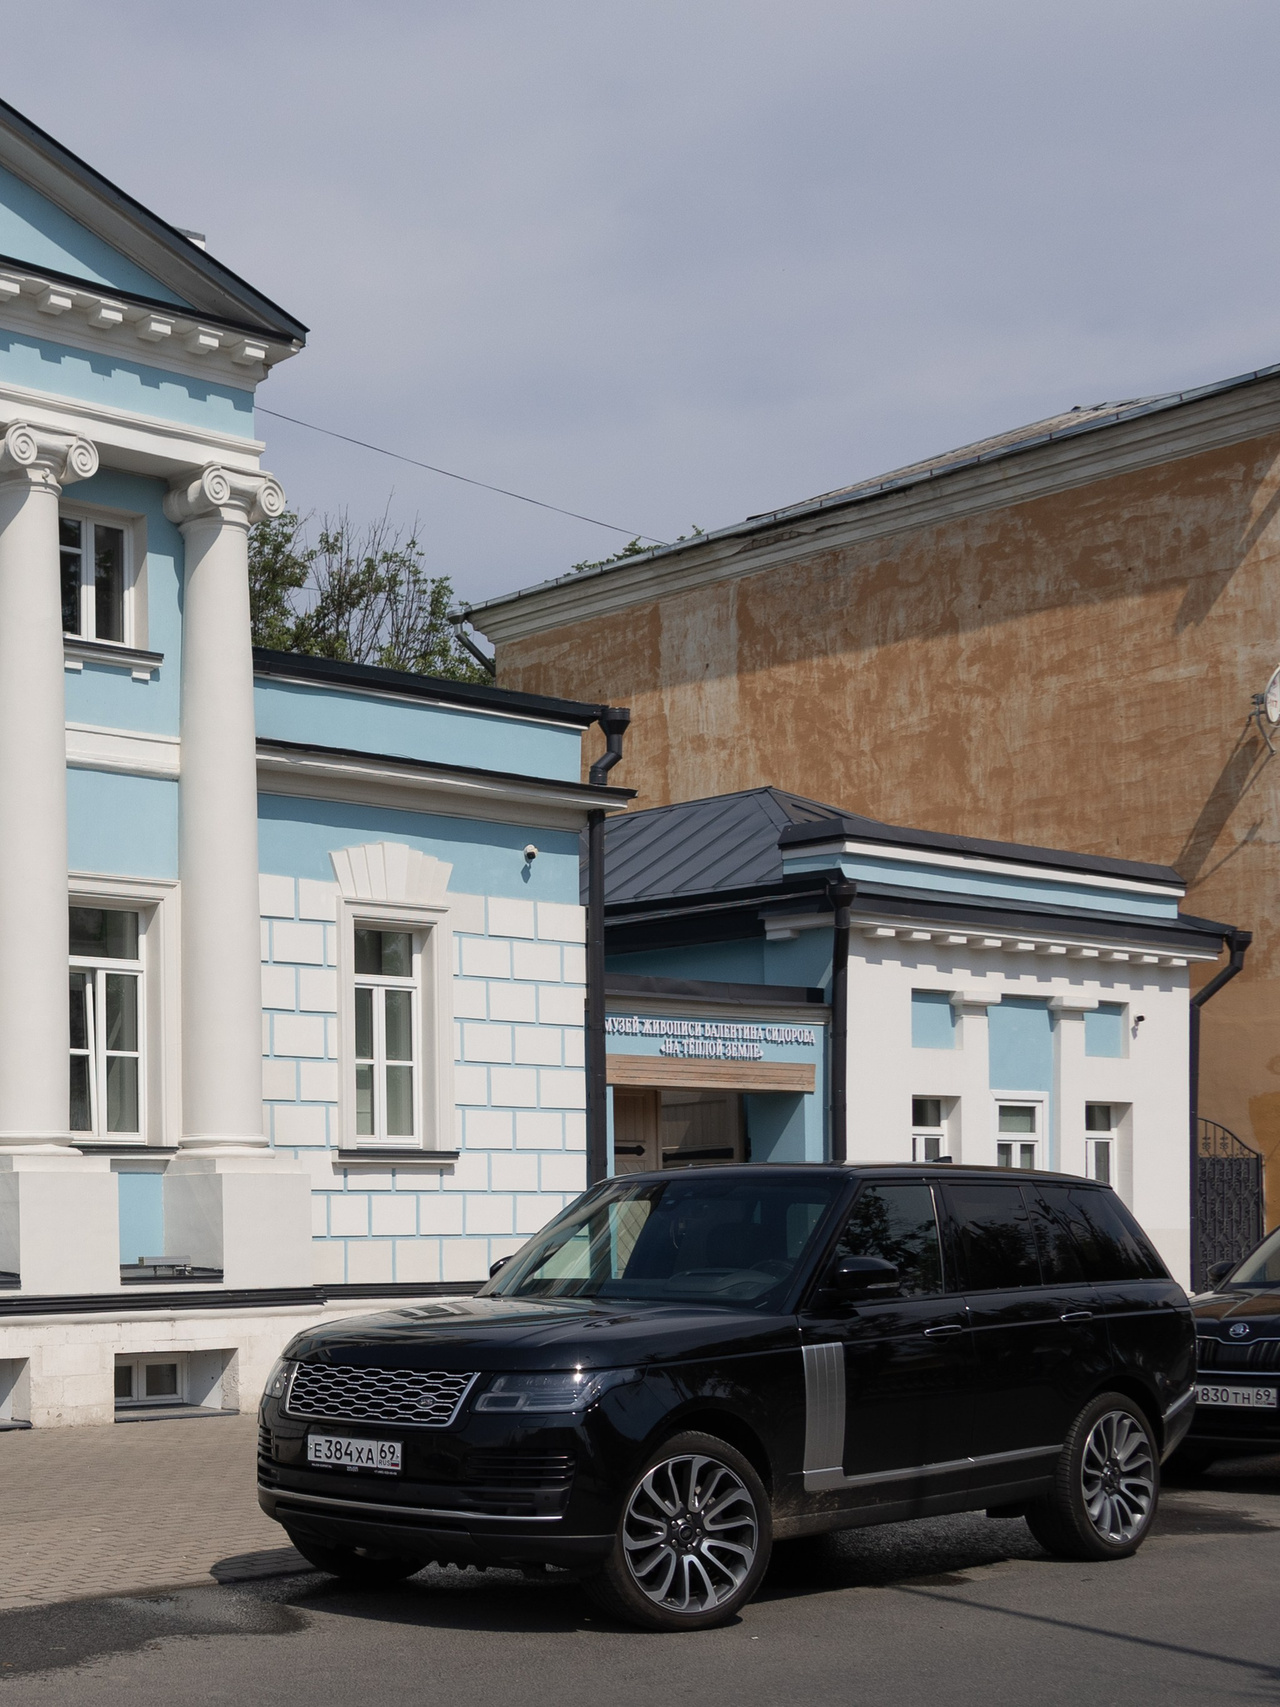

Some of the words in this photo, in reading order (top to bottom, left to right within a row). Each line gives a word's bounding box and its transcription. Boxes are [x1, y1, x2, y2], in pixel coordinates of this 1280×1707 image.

[605, 1016, 639, 1033] МУЗЕЙ
[642, 1019, 702, 1037] ЖИВОПИСИ
[704, 1022, 764, 1040] ВАЛЕНТИНА
[765, 1027, 816, 1043] СИДОРОВА
[682, 1038, 723, 1056] ТЁПЛОЙ
[1255, 1389, 1271, 1401] 69
[379, 1443, 396, 1461] 69
[378, 1459, 391, 1467] RUS
